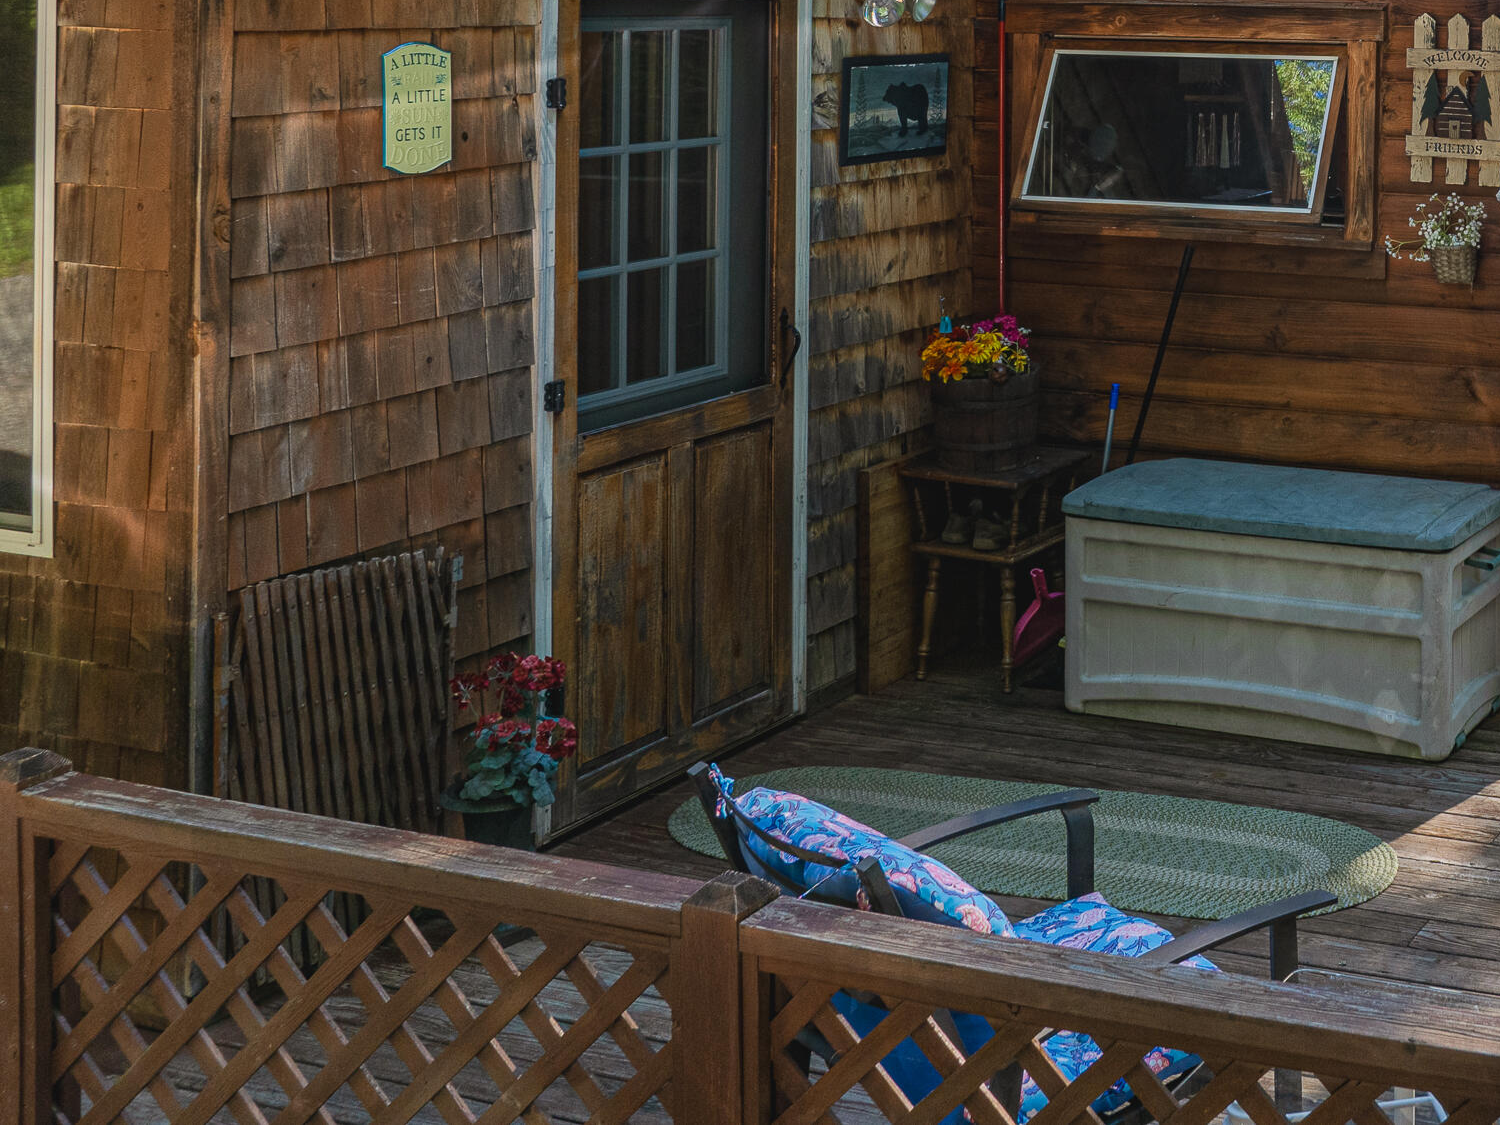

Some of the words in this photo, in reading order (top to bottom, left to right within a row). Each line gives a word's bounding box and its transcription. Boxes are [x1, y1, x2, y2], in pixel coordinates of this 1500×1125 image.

[391, 58, 399, 70] A
[402, 53, 447, 68] LITTLE
[1423, 50, 1490, 70] WELCOME
[392, 91, 400, 104] A
[407, 89, 446, 103] LITTLE
[396, 127, 426, 142] GETS
[432, 126, 442, 140] IT
[391, 141, 448, 166] DONE
[1425, 141, 1483, 156] FRIENDS
